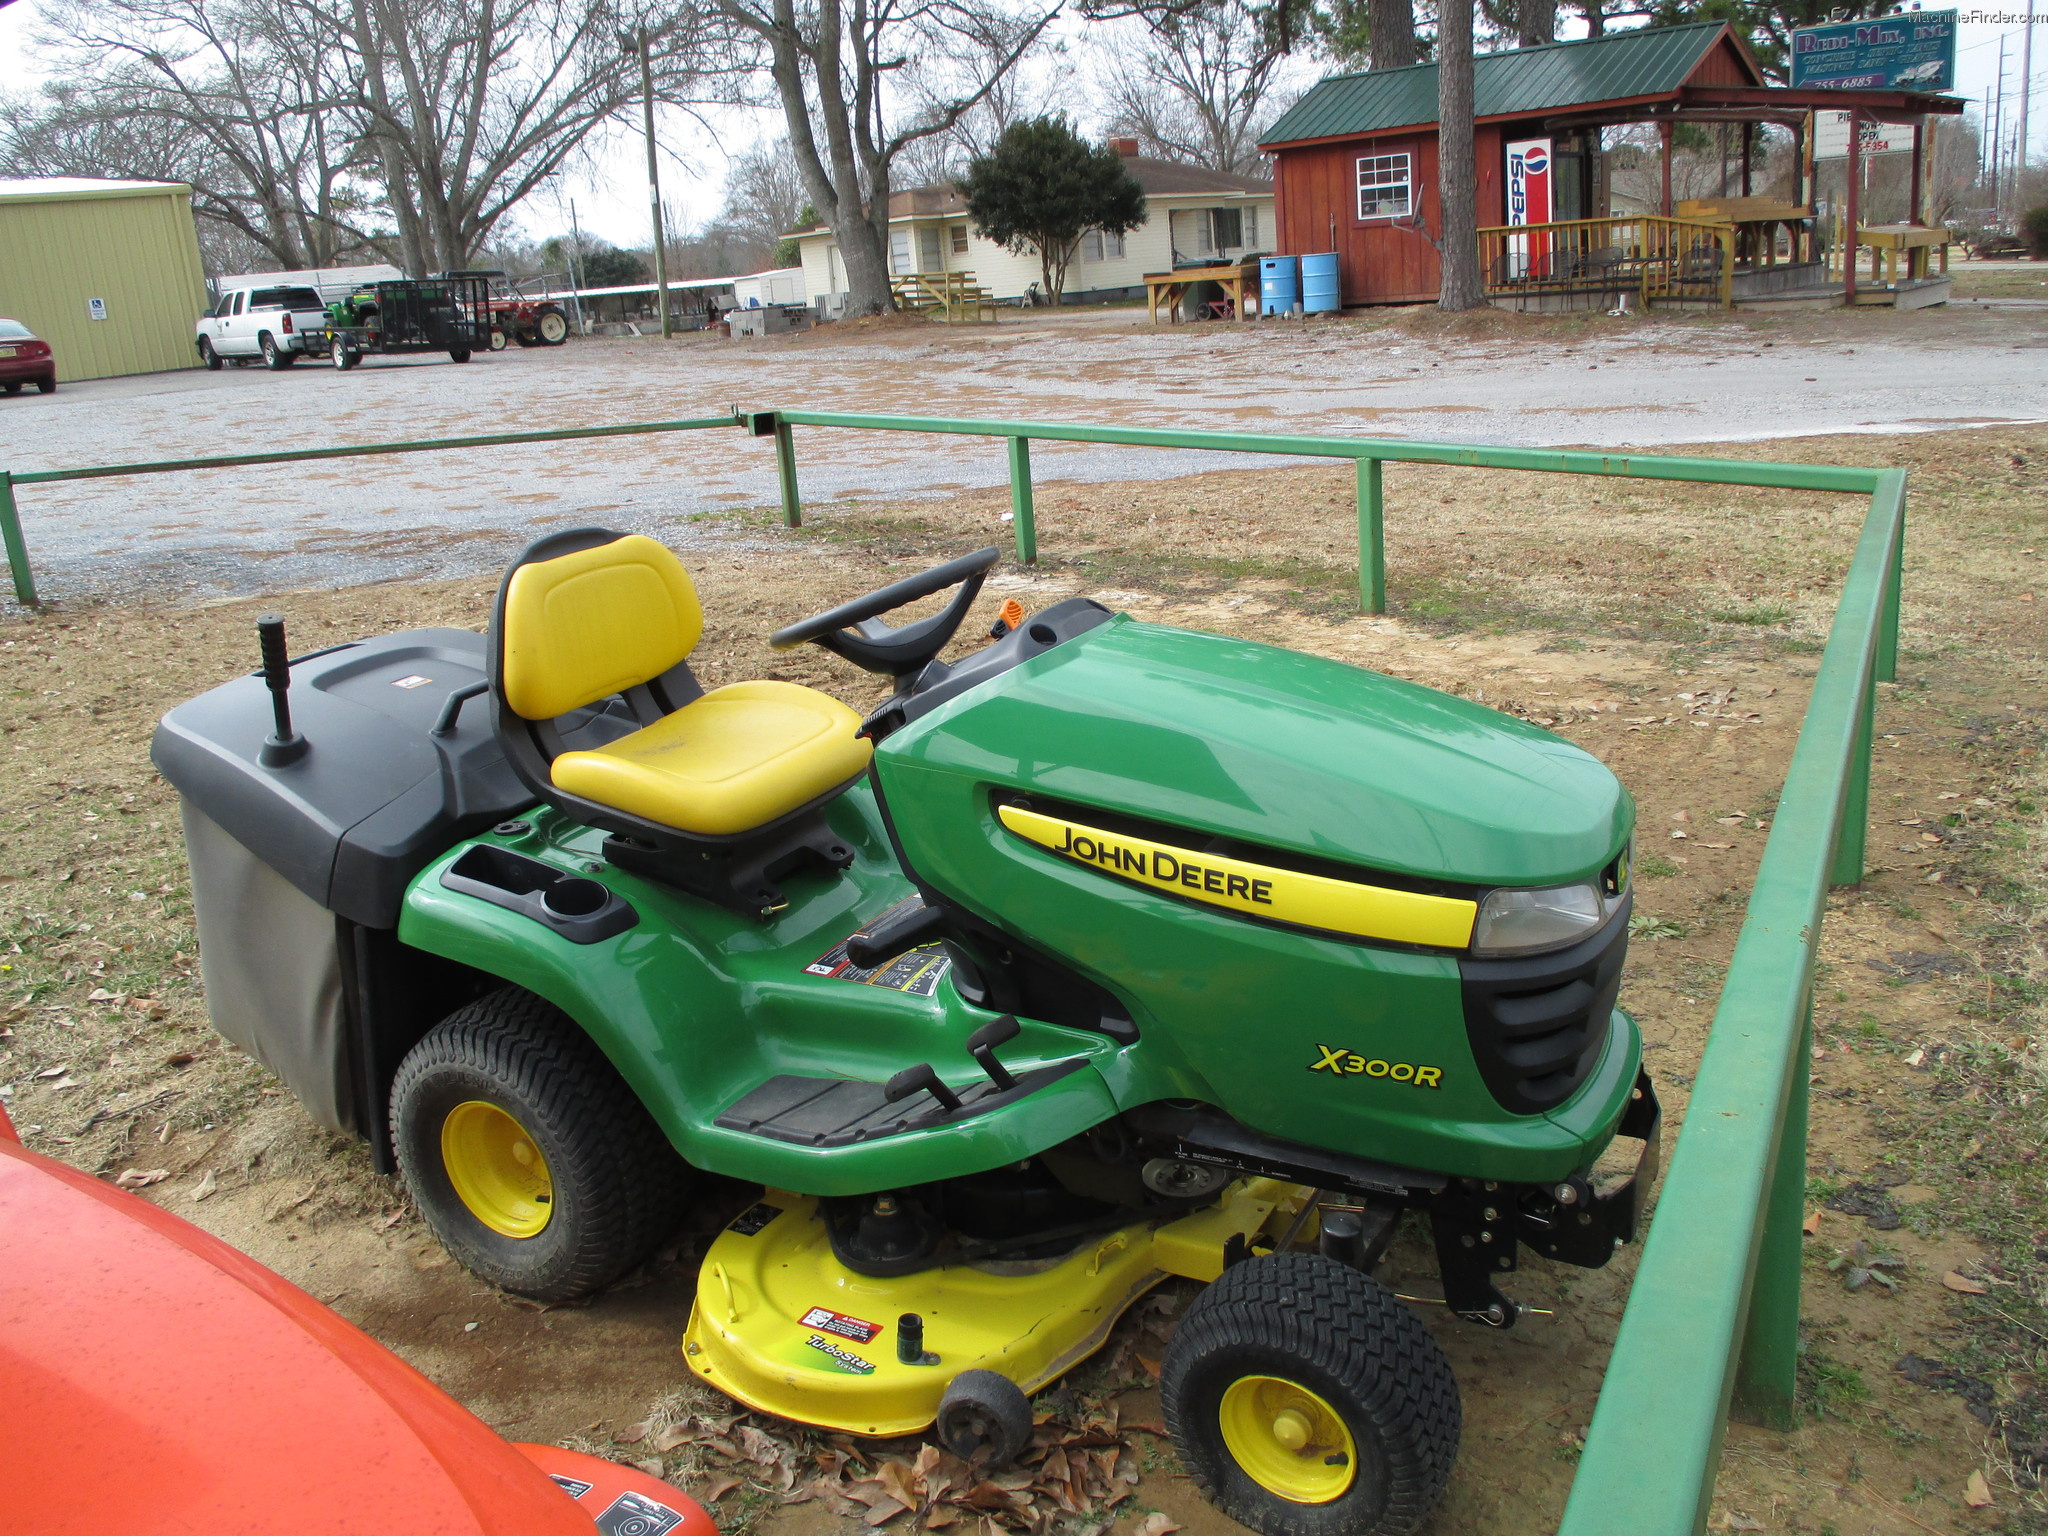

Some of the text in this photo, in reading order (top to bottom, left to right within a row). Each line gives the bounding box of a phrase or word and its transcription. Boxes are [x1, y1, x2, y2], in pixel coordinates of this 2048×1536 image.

[1913, 24, 1950, 41] INC.
[1815, 76, 1873, 89] 755-6885
[1054, 827, 1273, 905] JOHN DEERE
[1308, 1042, 1444, 1089] X300R
[848, 1317, 872, 1327] DANGER
[806, 1333, 876, 1370] TurboStar
[835, 1359, 863, 1375] System
